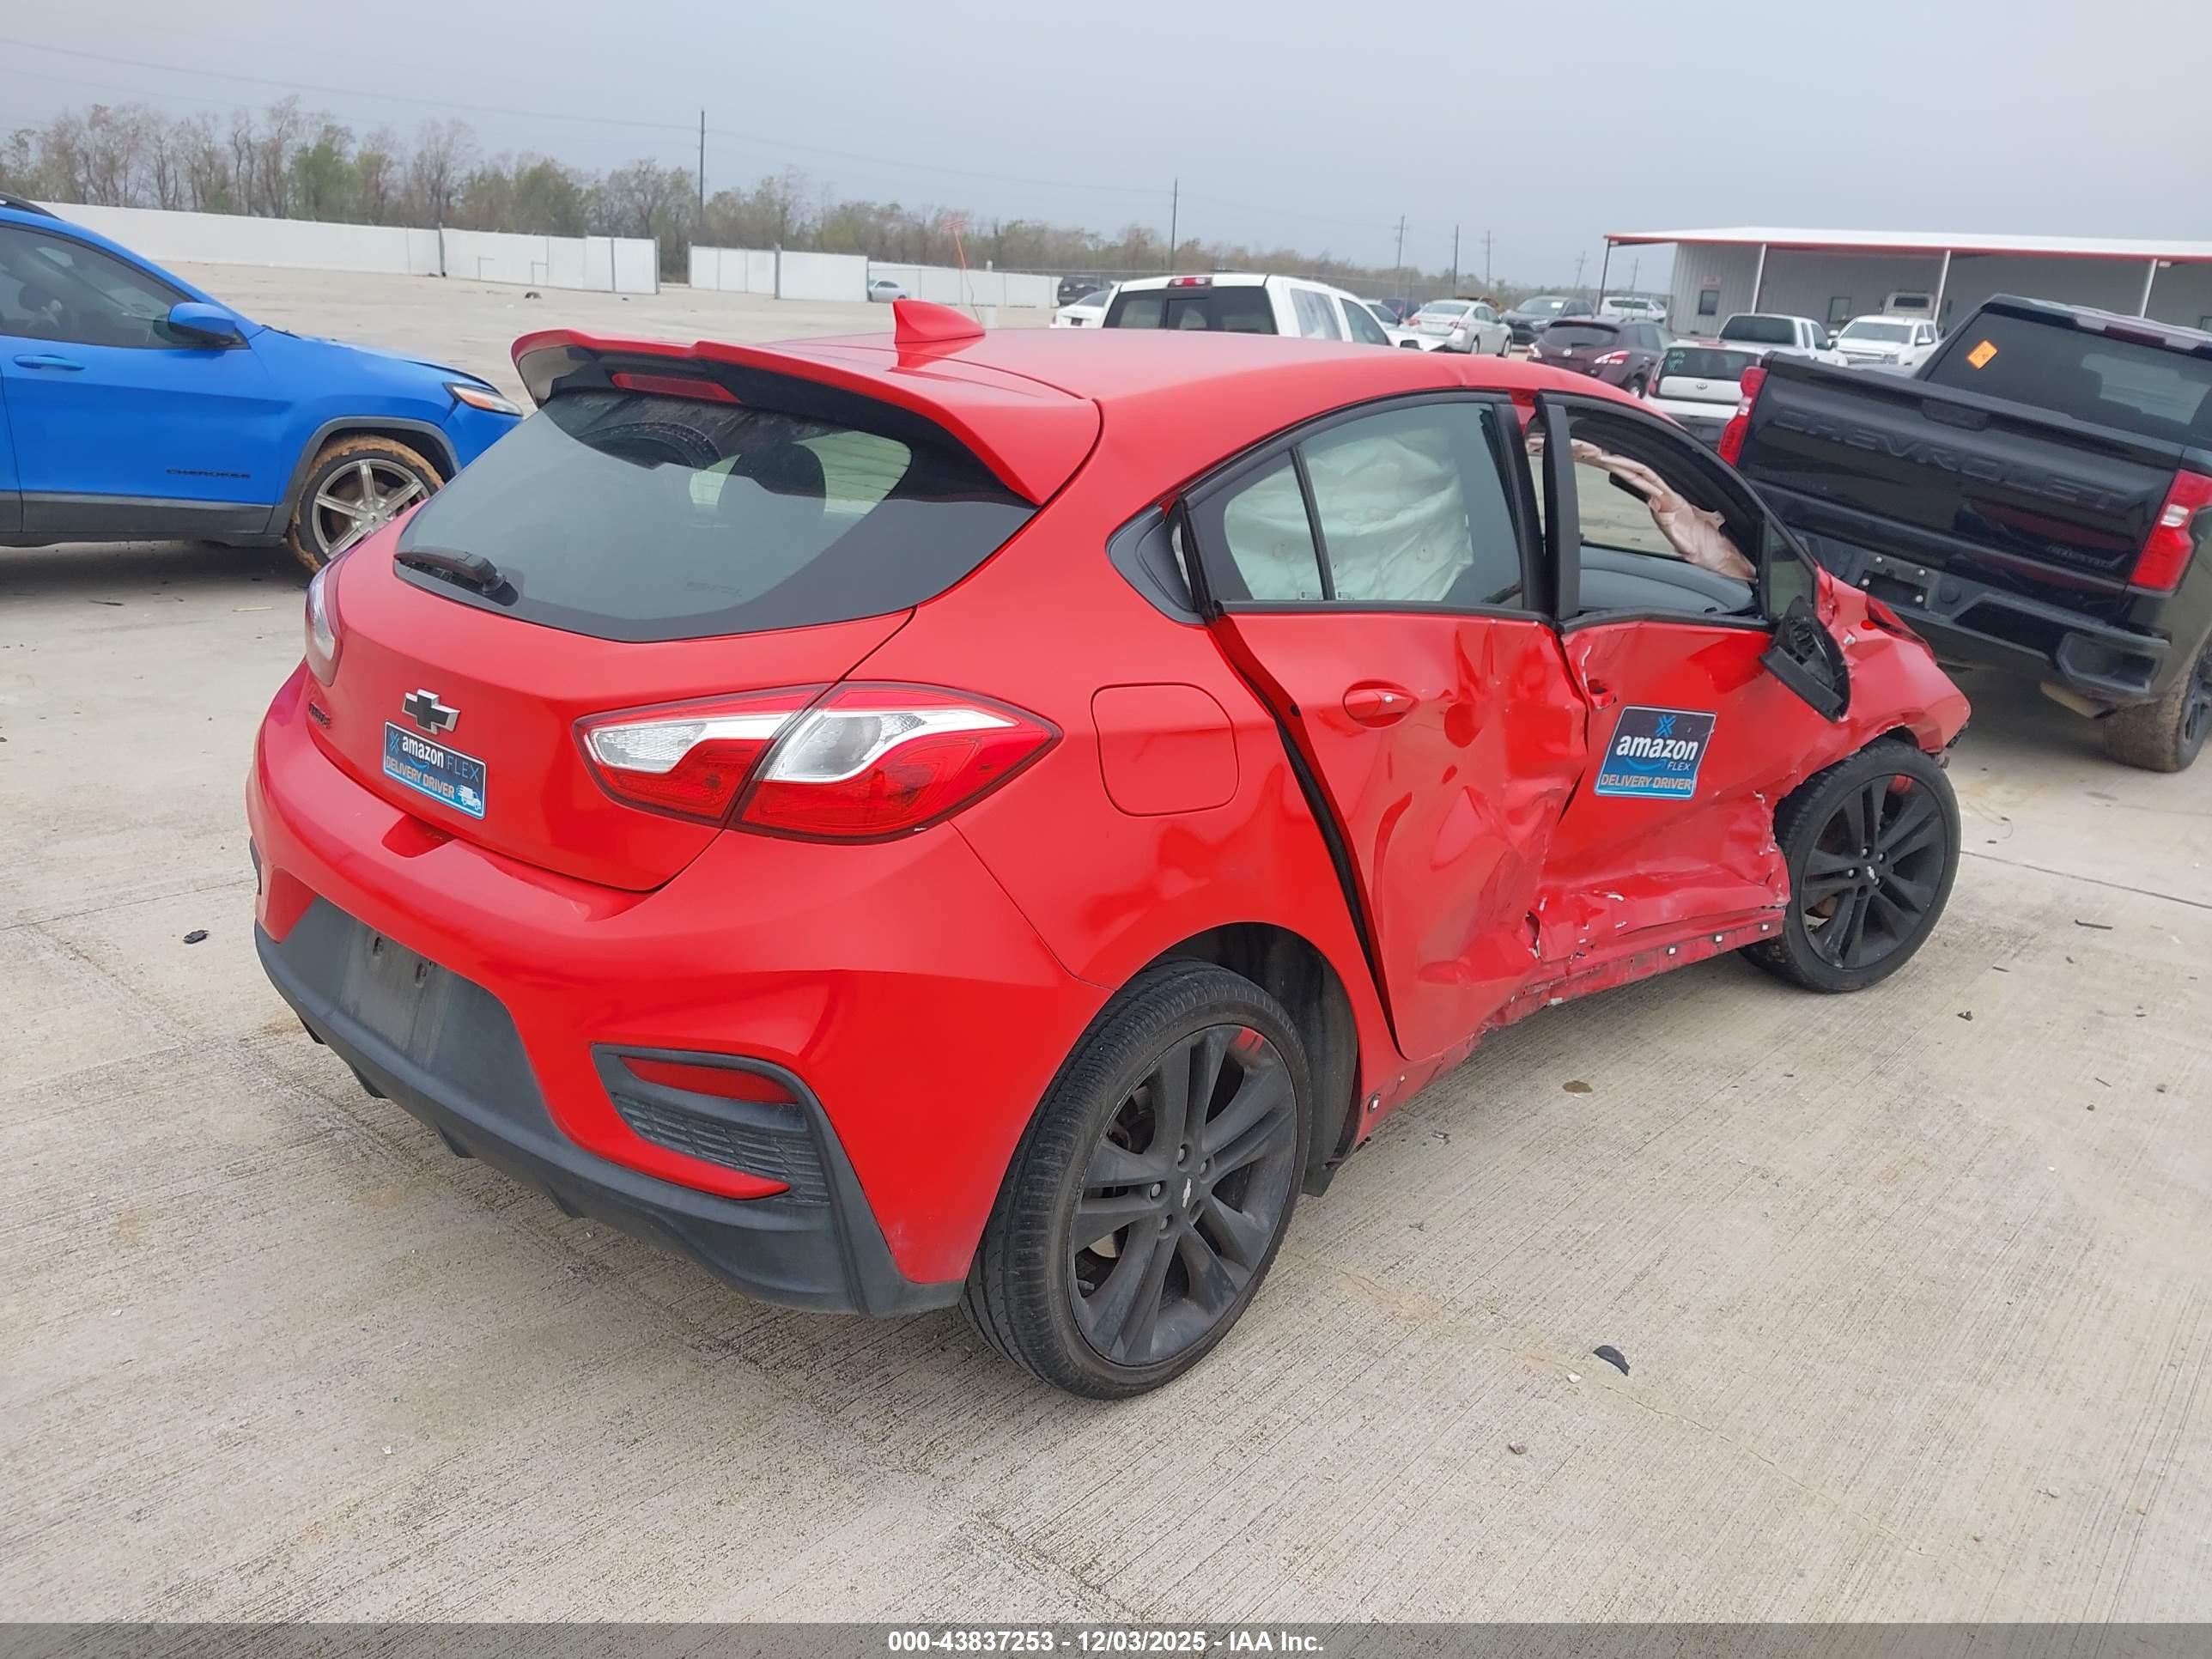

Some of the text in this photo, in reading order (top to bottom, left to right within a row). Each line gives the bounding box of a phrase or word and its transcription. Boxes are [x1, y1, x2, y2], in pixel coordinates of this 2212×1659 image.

[1772, 407, 2129, 509] CHEVROLET
[402, 736, 480, 781] amazon FLEX
[1616, 735, 1698, 761] amazon
[386, 755, 455, 799] DELIVERY DRIVER
[1601, 774, 1692, 790] DELIVERY DRIVER
[1667, 761, 1691, 771] FLEX
